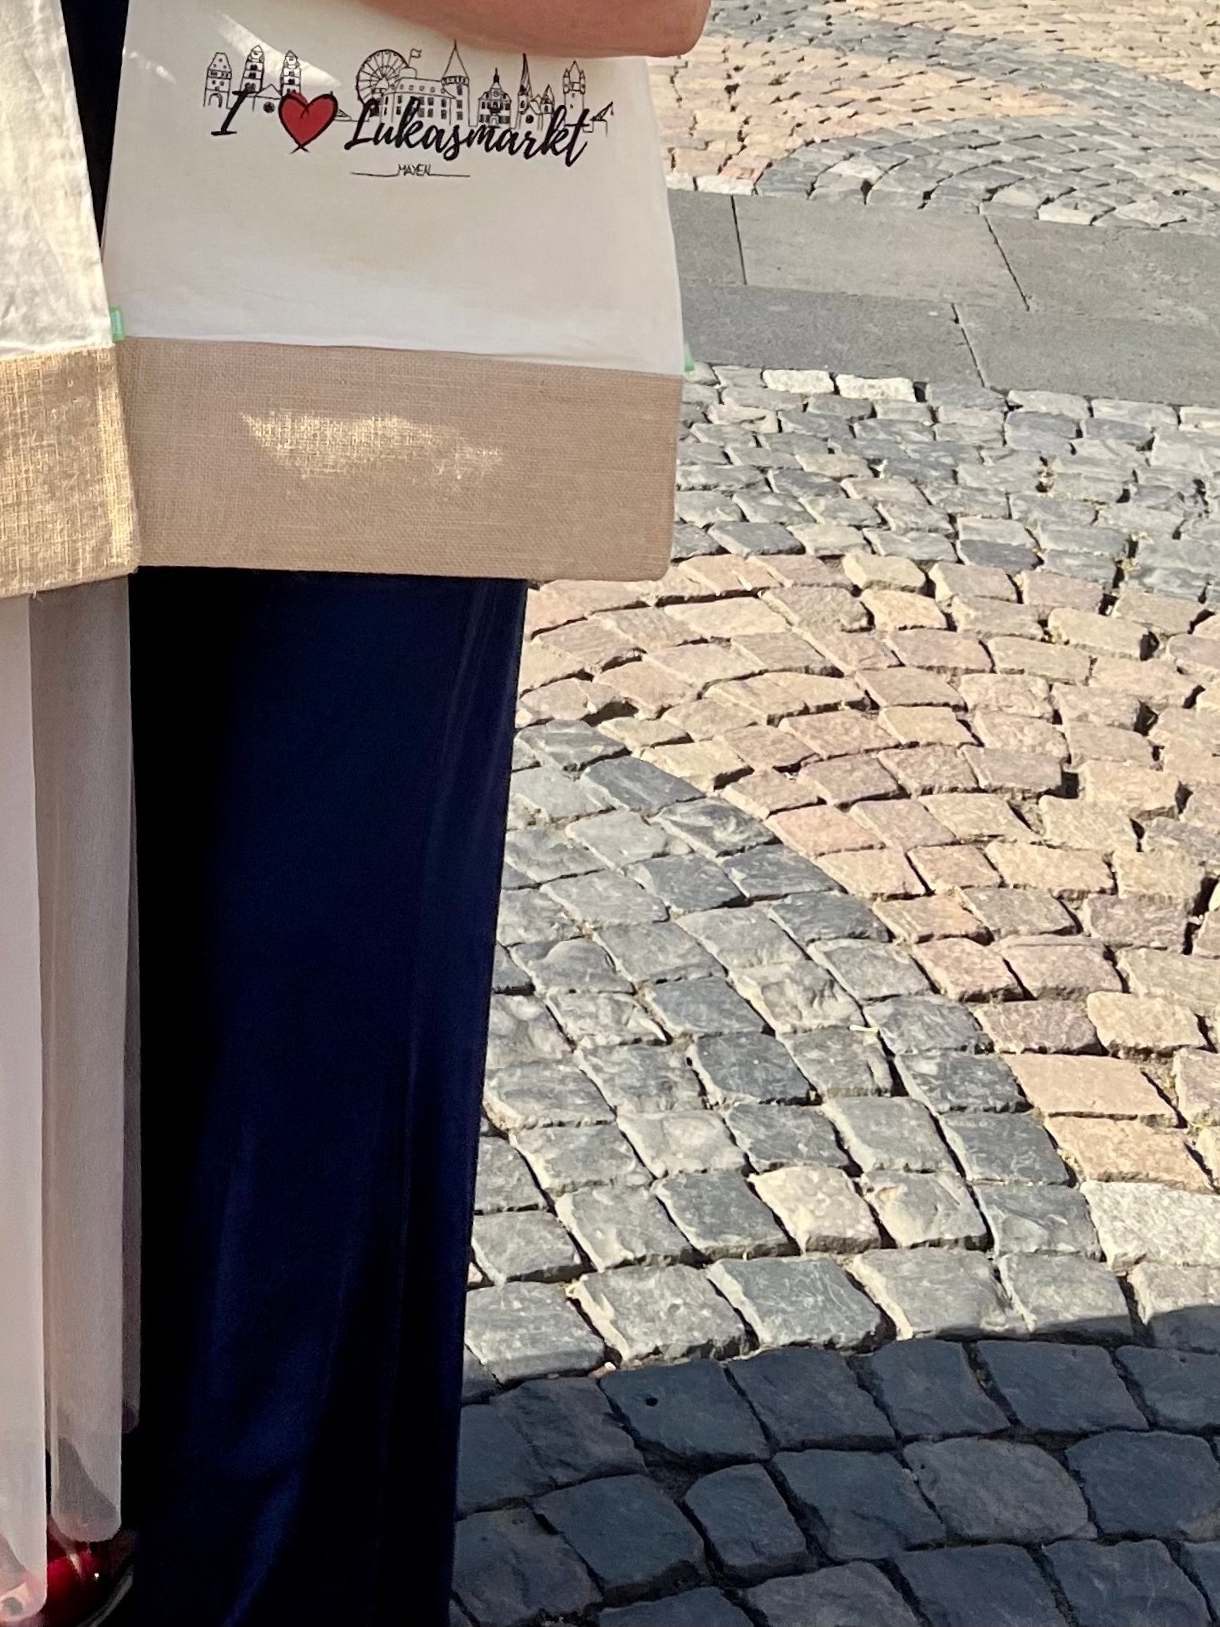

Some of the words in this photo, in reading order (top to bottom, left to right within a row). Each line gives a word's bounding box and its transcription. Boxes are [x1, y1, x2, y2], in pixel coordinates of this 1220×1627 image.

[211, 89, 249, 136] I
[344, 96, 590, 168] Lukasmarkt
[397, 162, 432, 177] MAYEN
